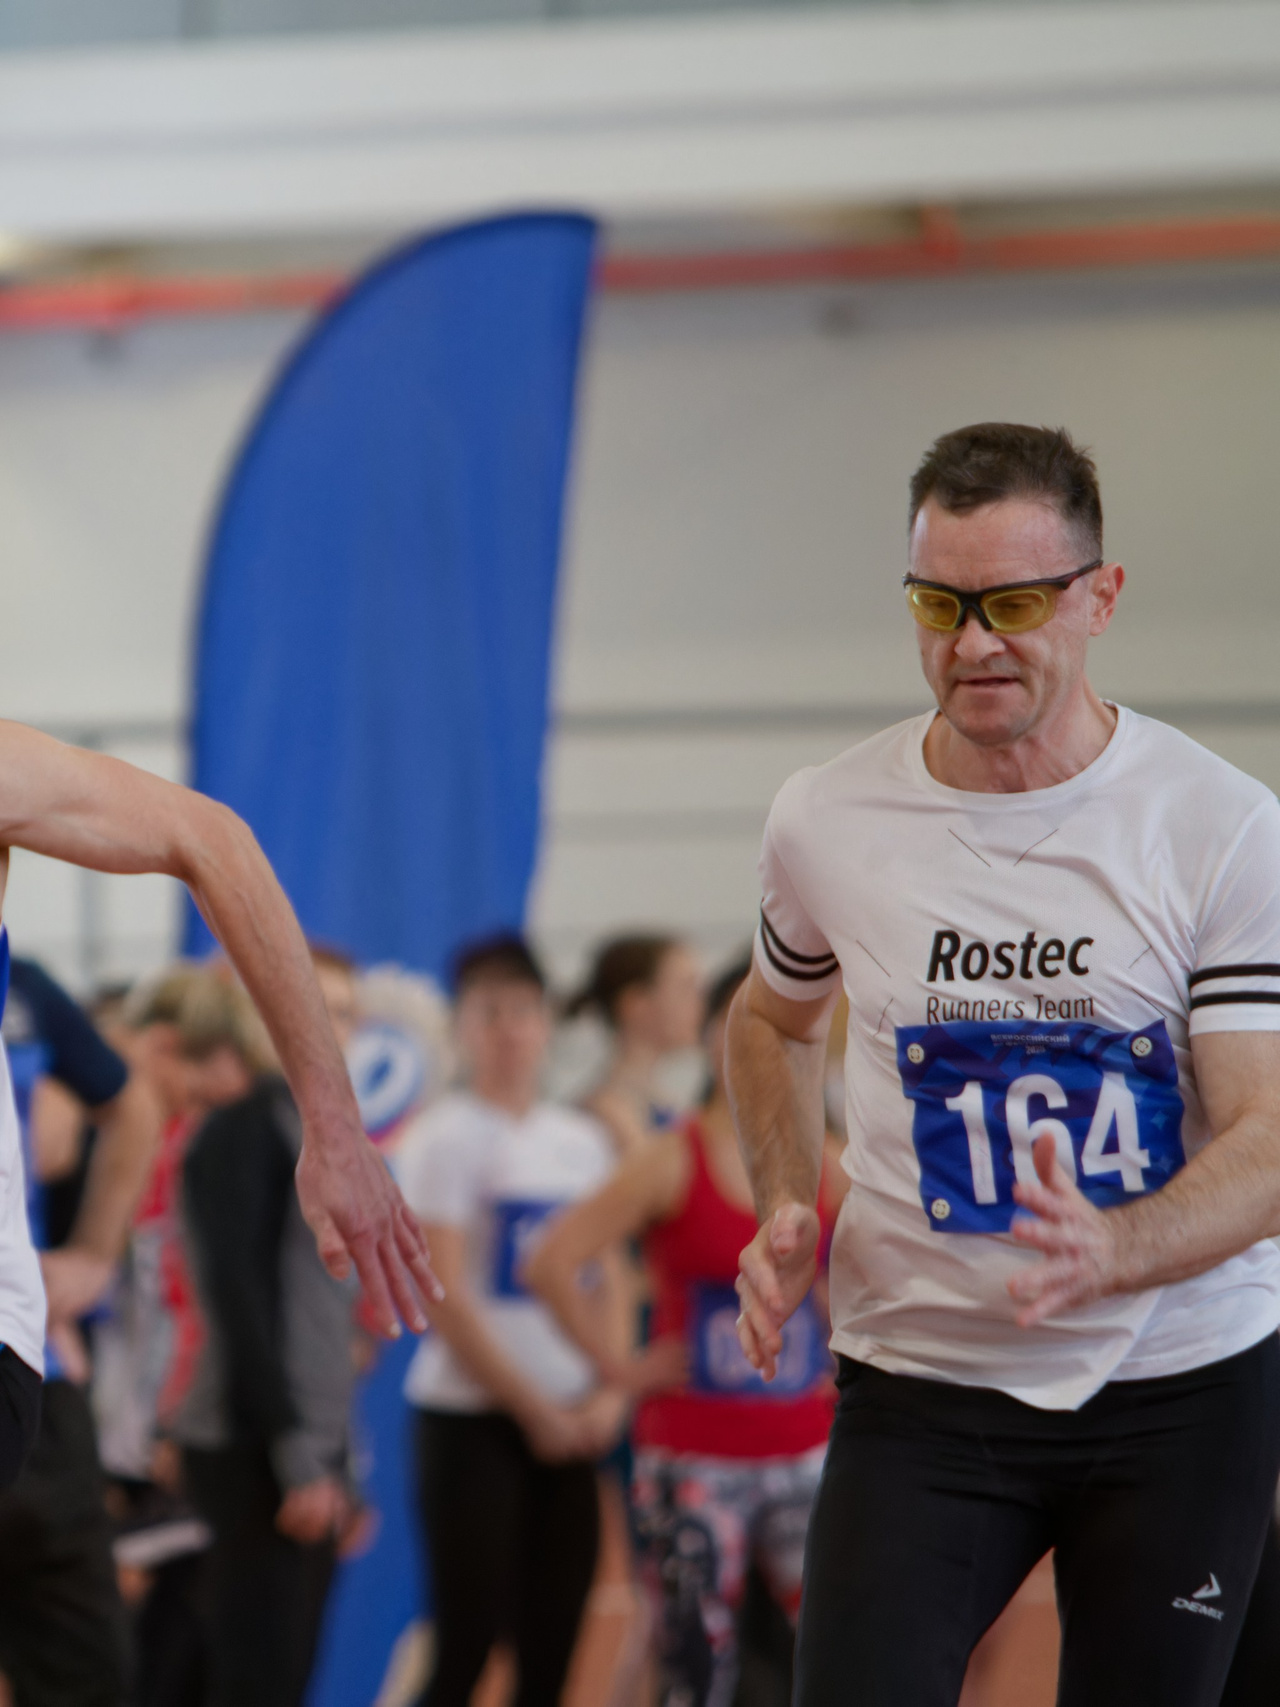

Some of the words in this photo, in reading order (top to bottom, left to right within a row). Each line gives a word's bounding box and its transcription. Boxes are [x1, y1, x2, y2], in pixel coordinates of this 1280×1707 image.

[926, 929, 1094, 983] Rostec
[926, 995, 1025, 1024] Runners
[1033, 993, 1095, 1020] Team
[945, 1071, 1150, 1205] 164
